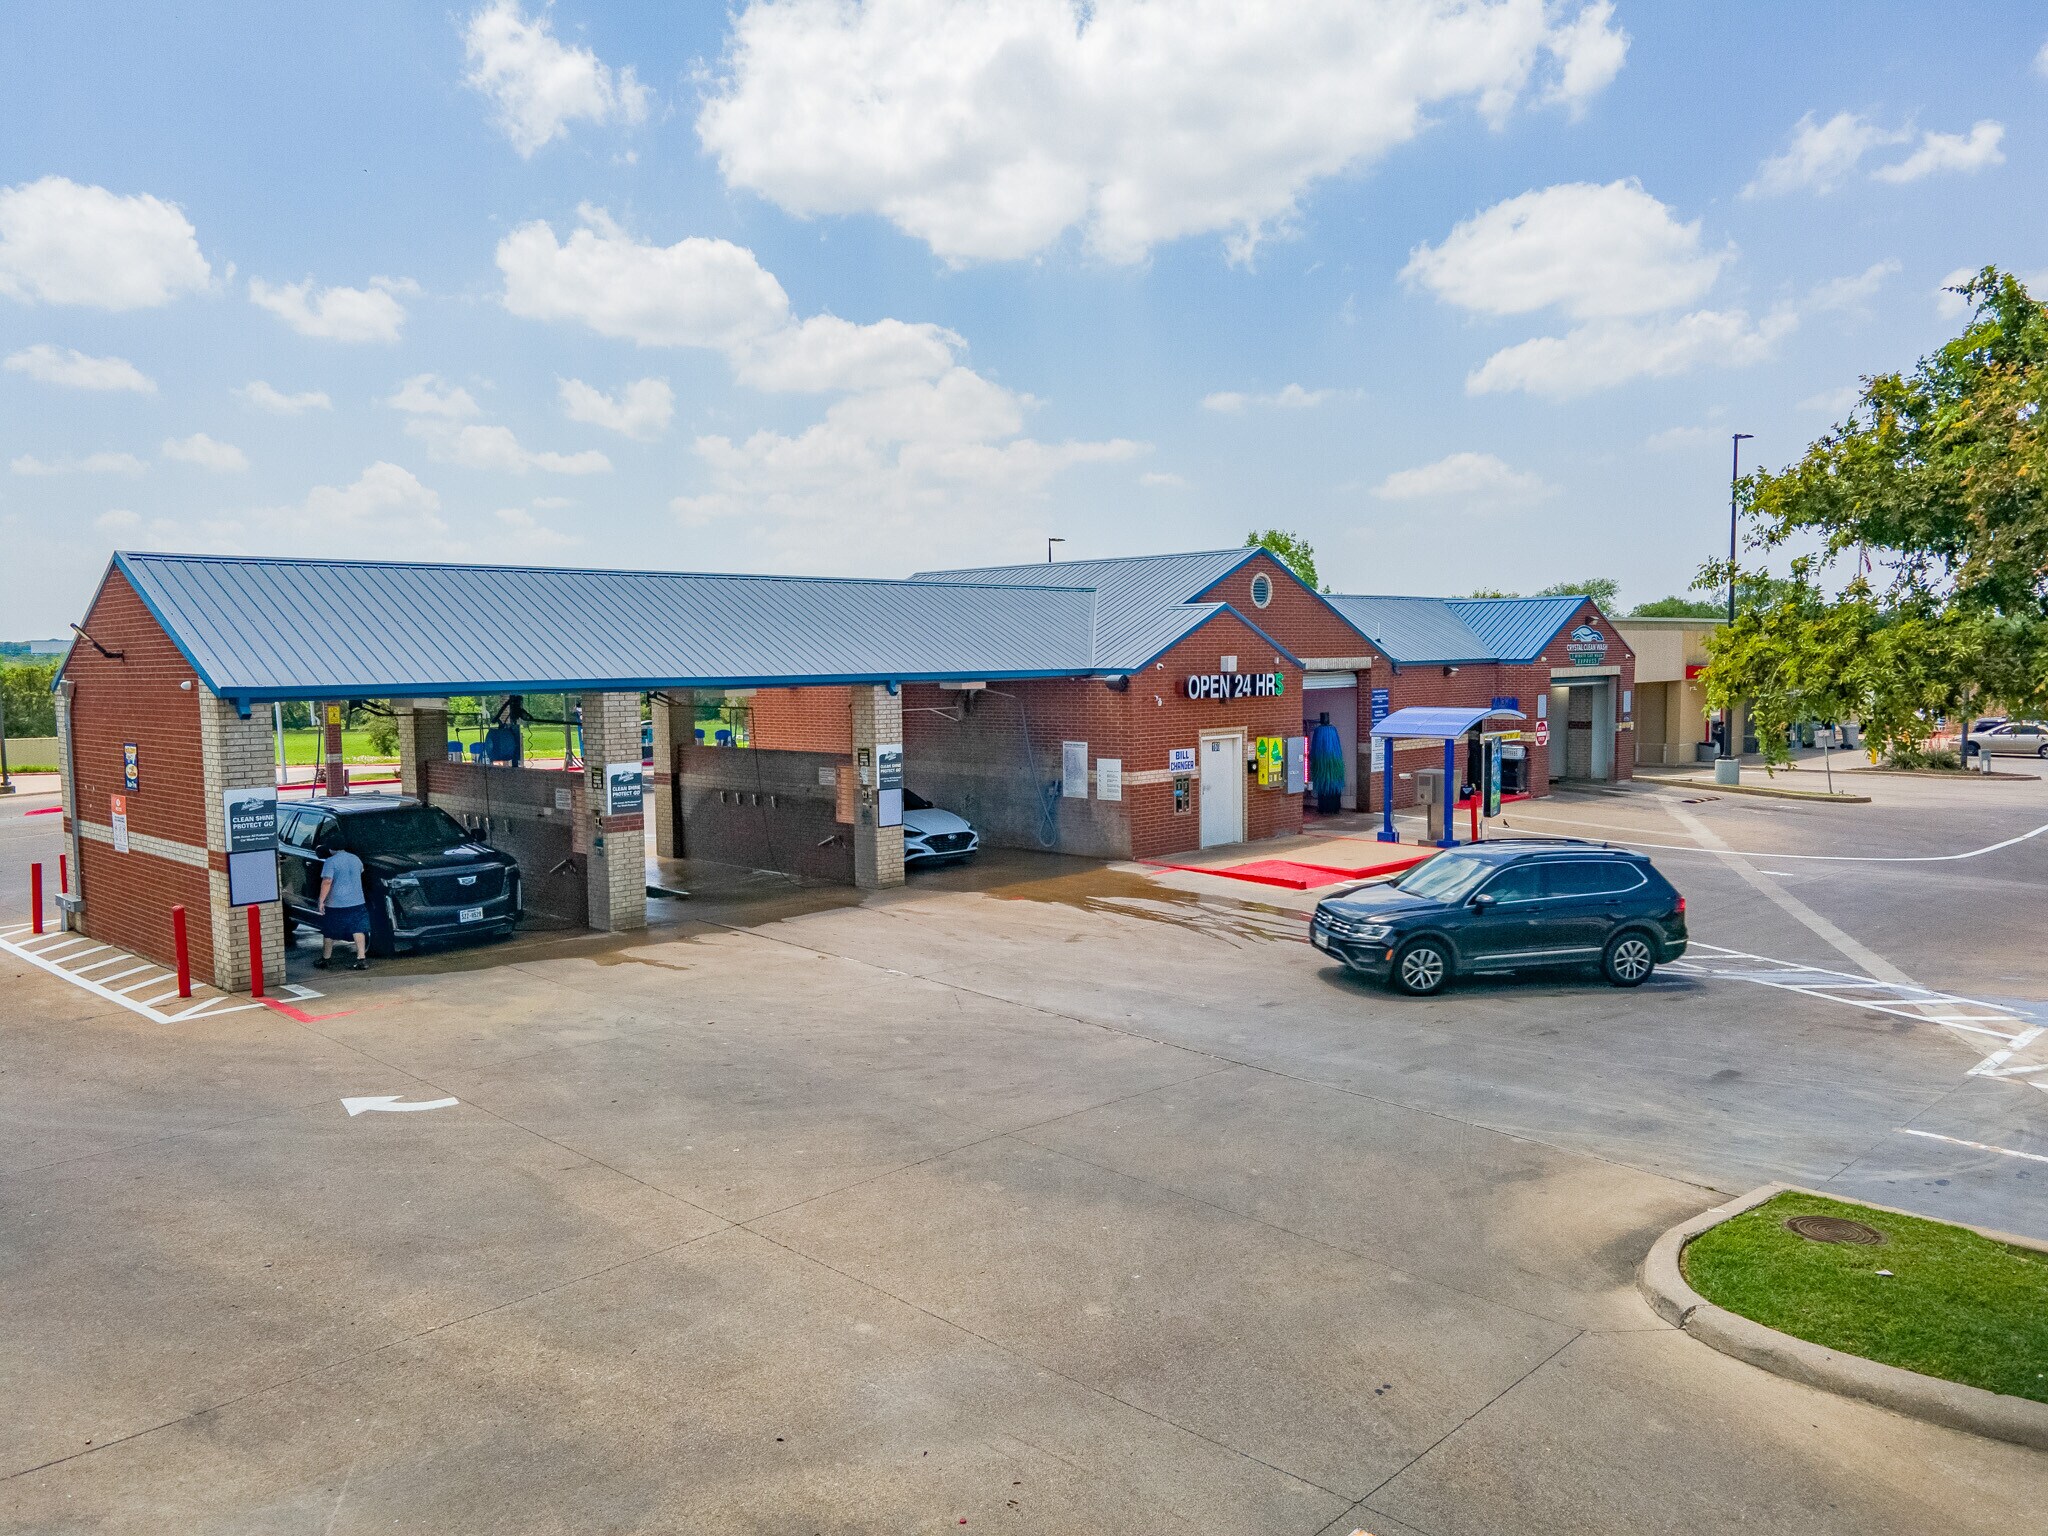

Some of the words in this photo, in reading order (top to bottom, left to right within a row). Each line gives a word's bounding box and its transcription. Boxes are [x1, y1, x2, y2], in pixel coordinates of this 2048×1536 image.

[1188, 674, 1230, 699] OPEN
[1234, 674, 1251, 698] 24
[1176, 750, 1189, 760] BILL
[1171, 761, 1194, 771] CHANGER
